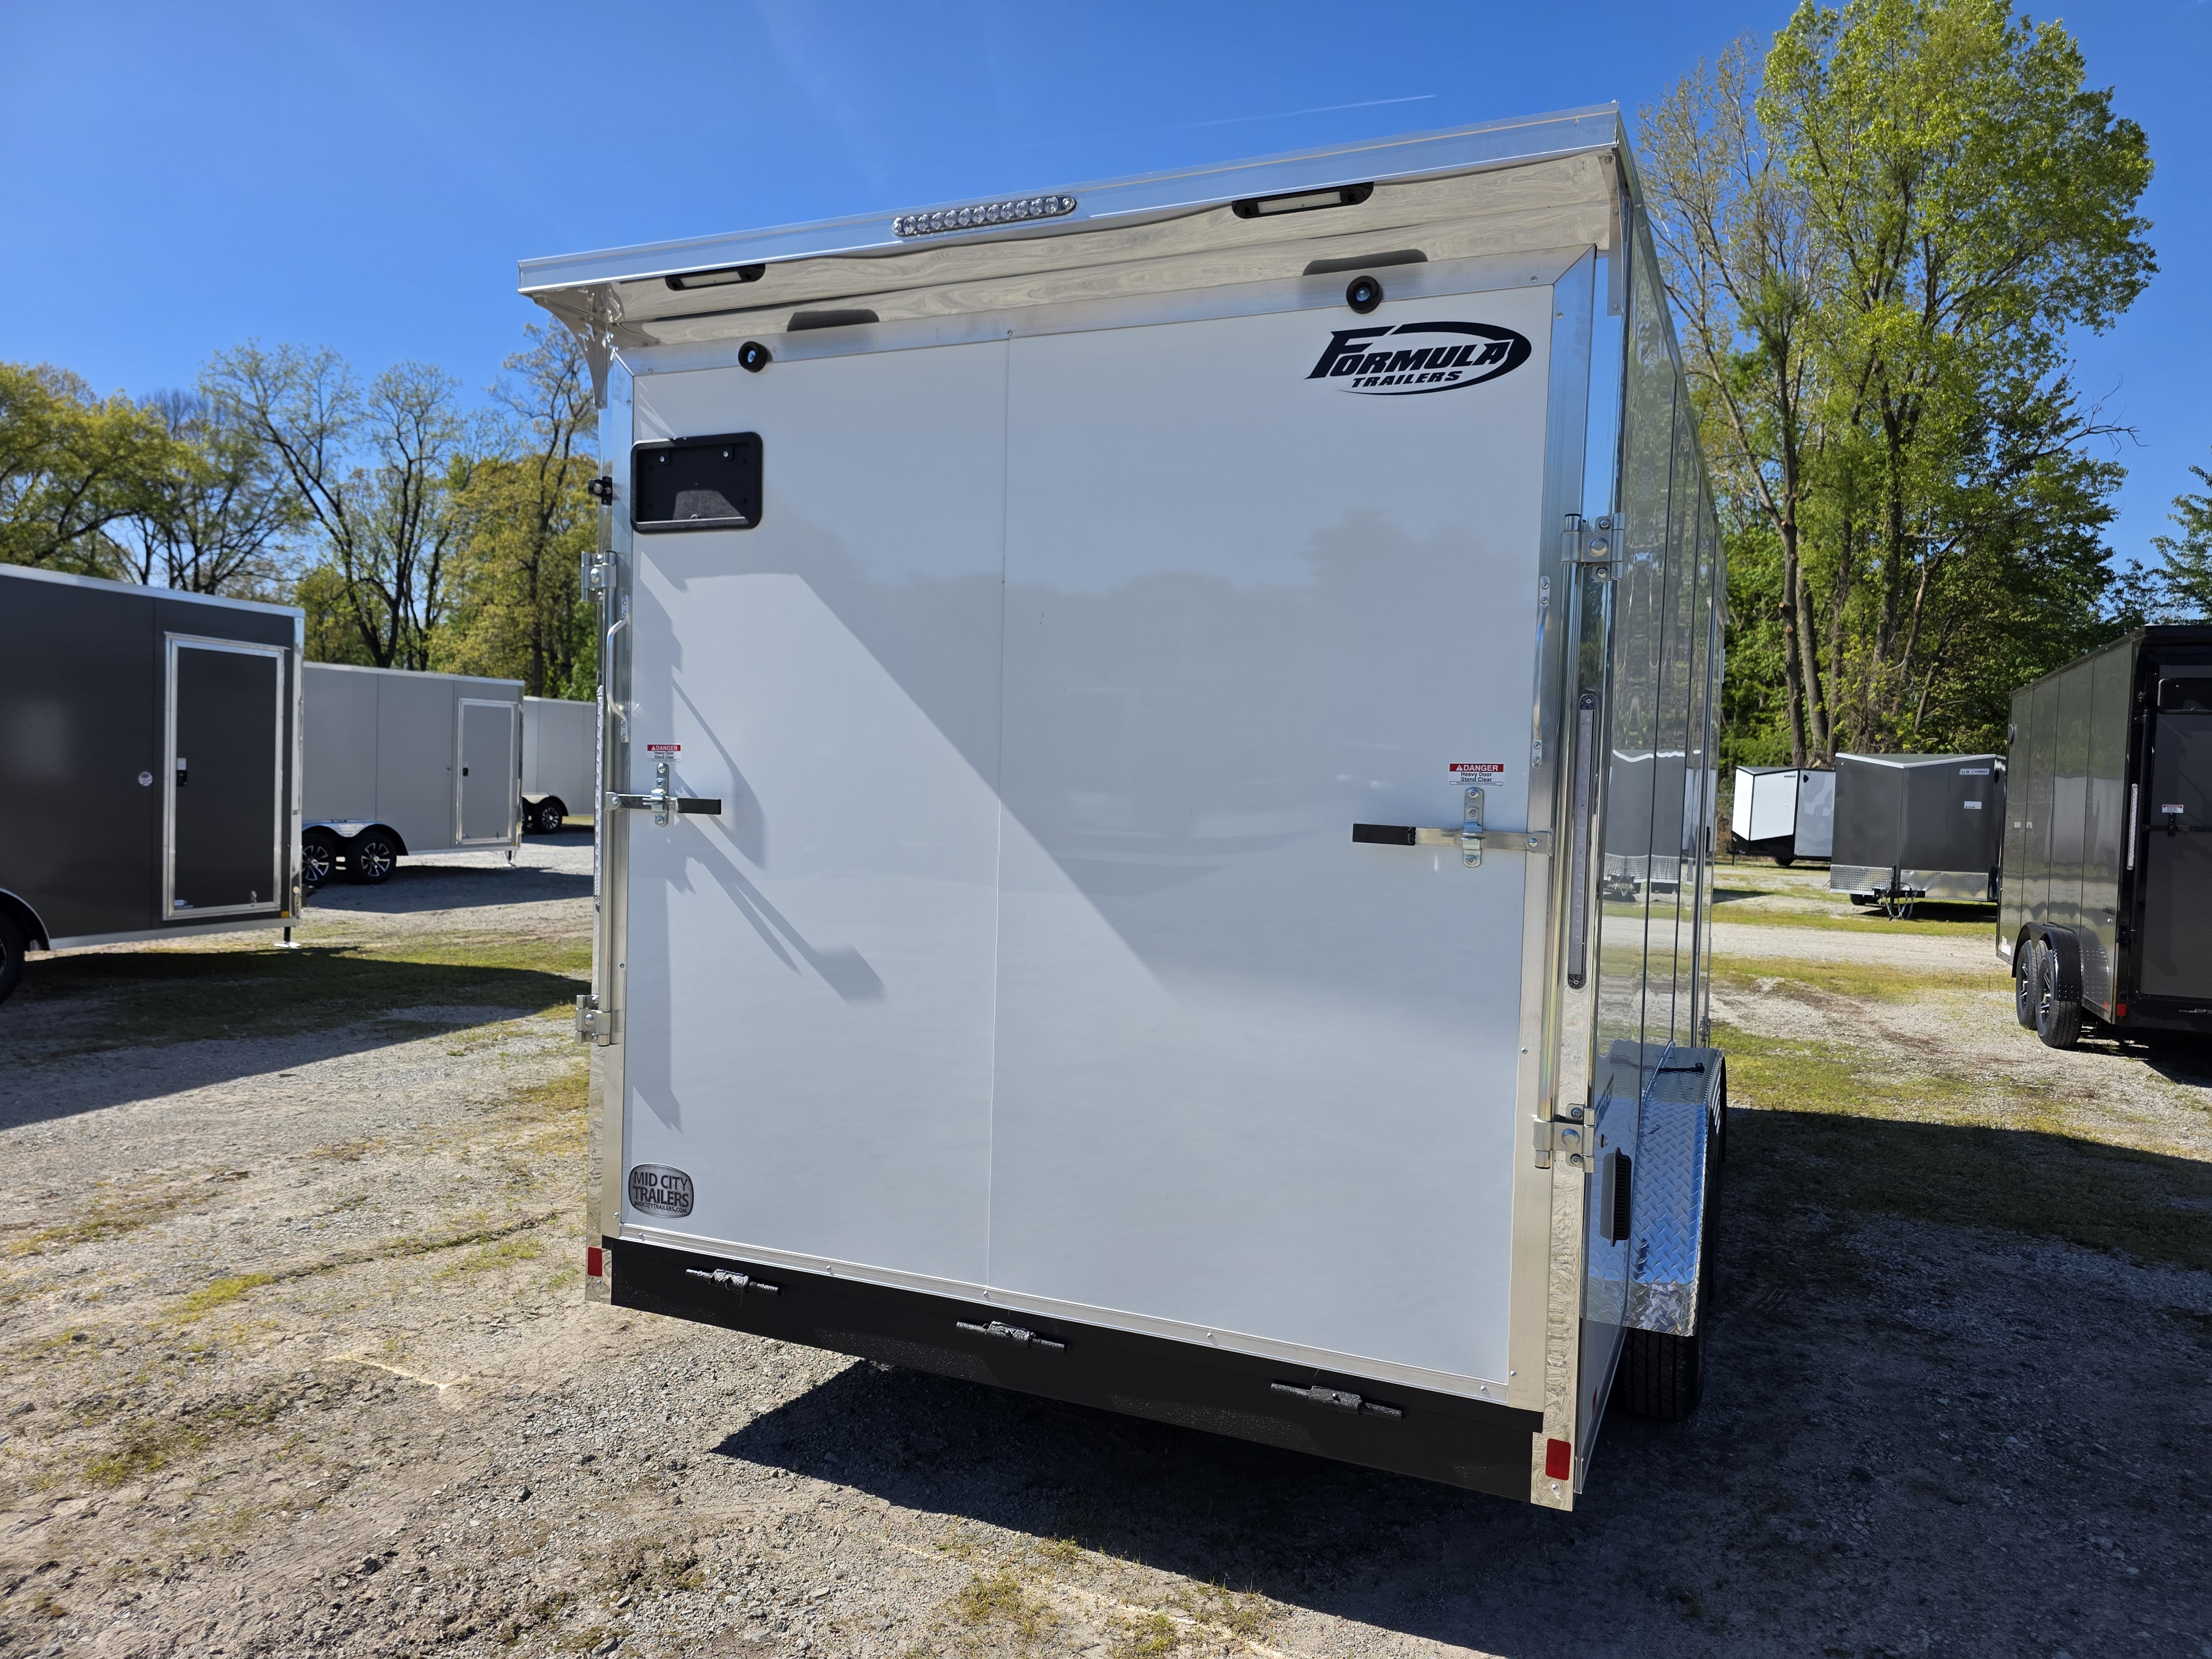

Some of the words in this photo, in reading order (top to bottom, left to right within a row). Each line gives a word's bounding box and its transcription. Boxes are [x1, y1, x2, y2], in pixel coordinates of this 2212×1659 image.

[1305, 325, 1511, 380] FORMULA
[1352, 370, 1463, 388] TRAILERS
[634, 1171, 658, 1187] MID
[660, 1175, 688, 1191] CITY
[633, 1186, 689, 1208] TRAILERS
